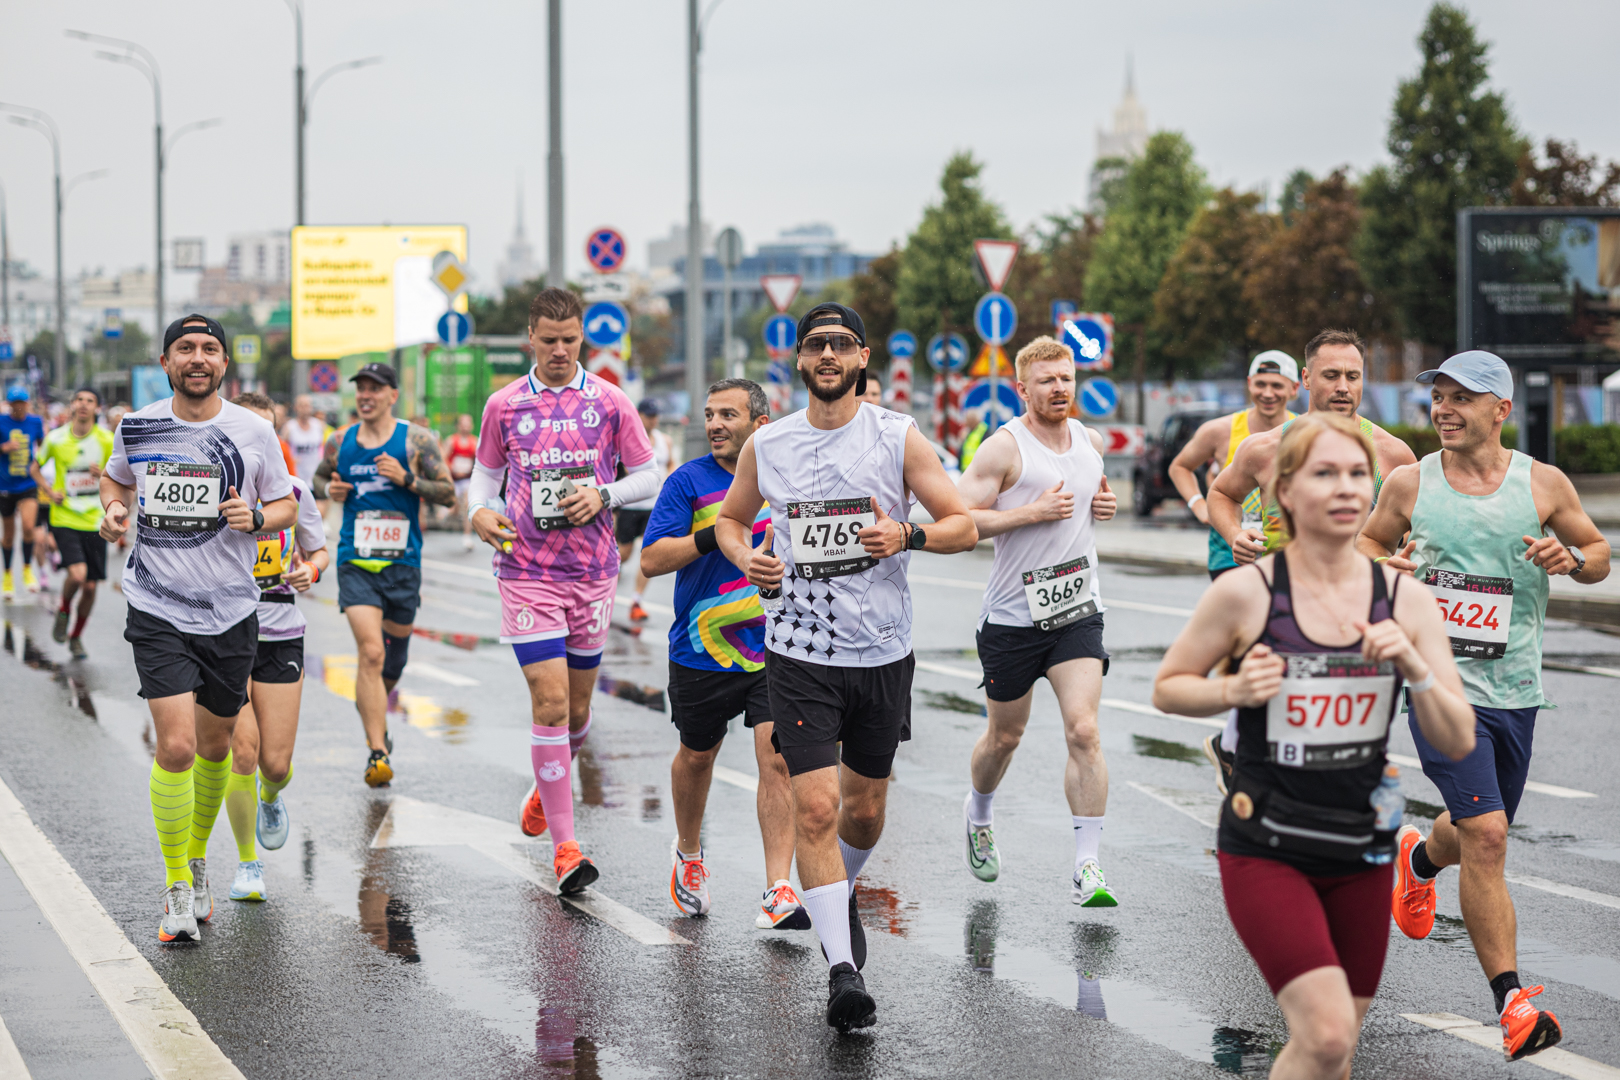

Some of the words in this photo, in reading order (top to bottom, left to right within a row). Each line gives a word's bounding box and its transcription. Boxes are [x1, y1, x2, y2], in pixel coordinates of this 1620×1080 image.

[552, 419, 578, 433] ВТБ
[520, 447, 599, 467] BetBoom
[180, 470, 191, 478] 15
[154, 482, 209, 505] 4802
[827, 508, 839, 516] 15
[841, 506, 861, 514] KM
[151, 516, 160, 528] B
[363, 526, 402, 542] 7168
[802, 521, 864, 548] 4769
[823, 548, 846, 556] ИВАН
[802, 565, 814, 578] B
[1036, 577, 1084, 607] 3669
[1466, 584, 1480, 592] 15
[1482, 585, 1503, 595] KM
[1050, 597, 1076, 612] ЕВГЕНИЙ
[587, 597, 612, 634] 30
[1436, 597, 1499, 631] 5424
[1286, 693, 1378, 728] 5707
[1284, 744, 1297, 761] B
